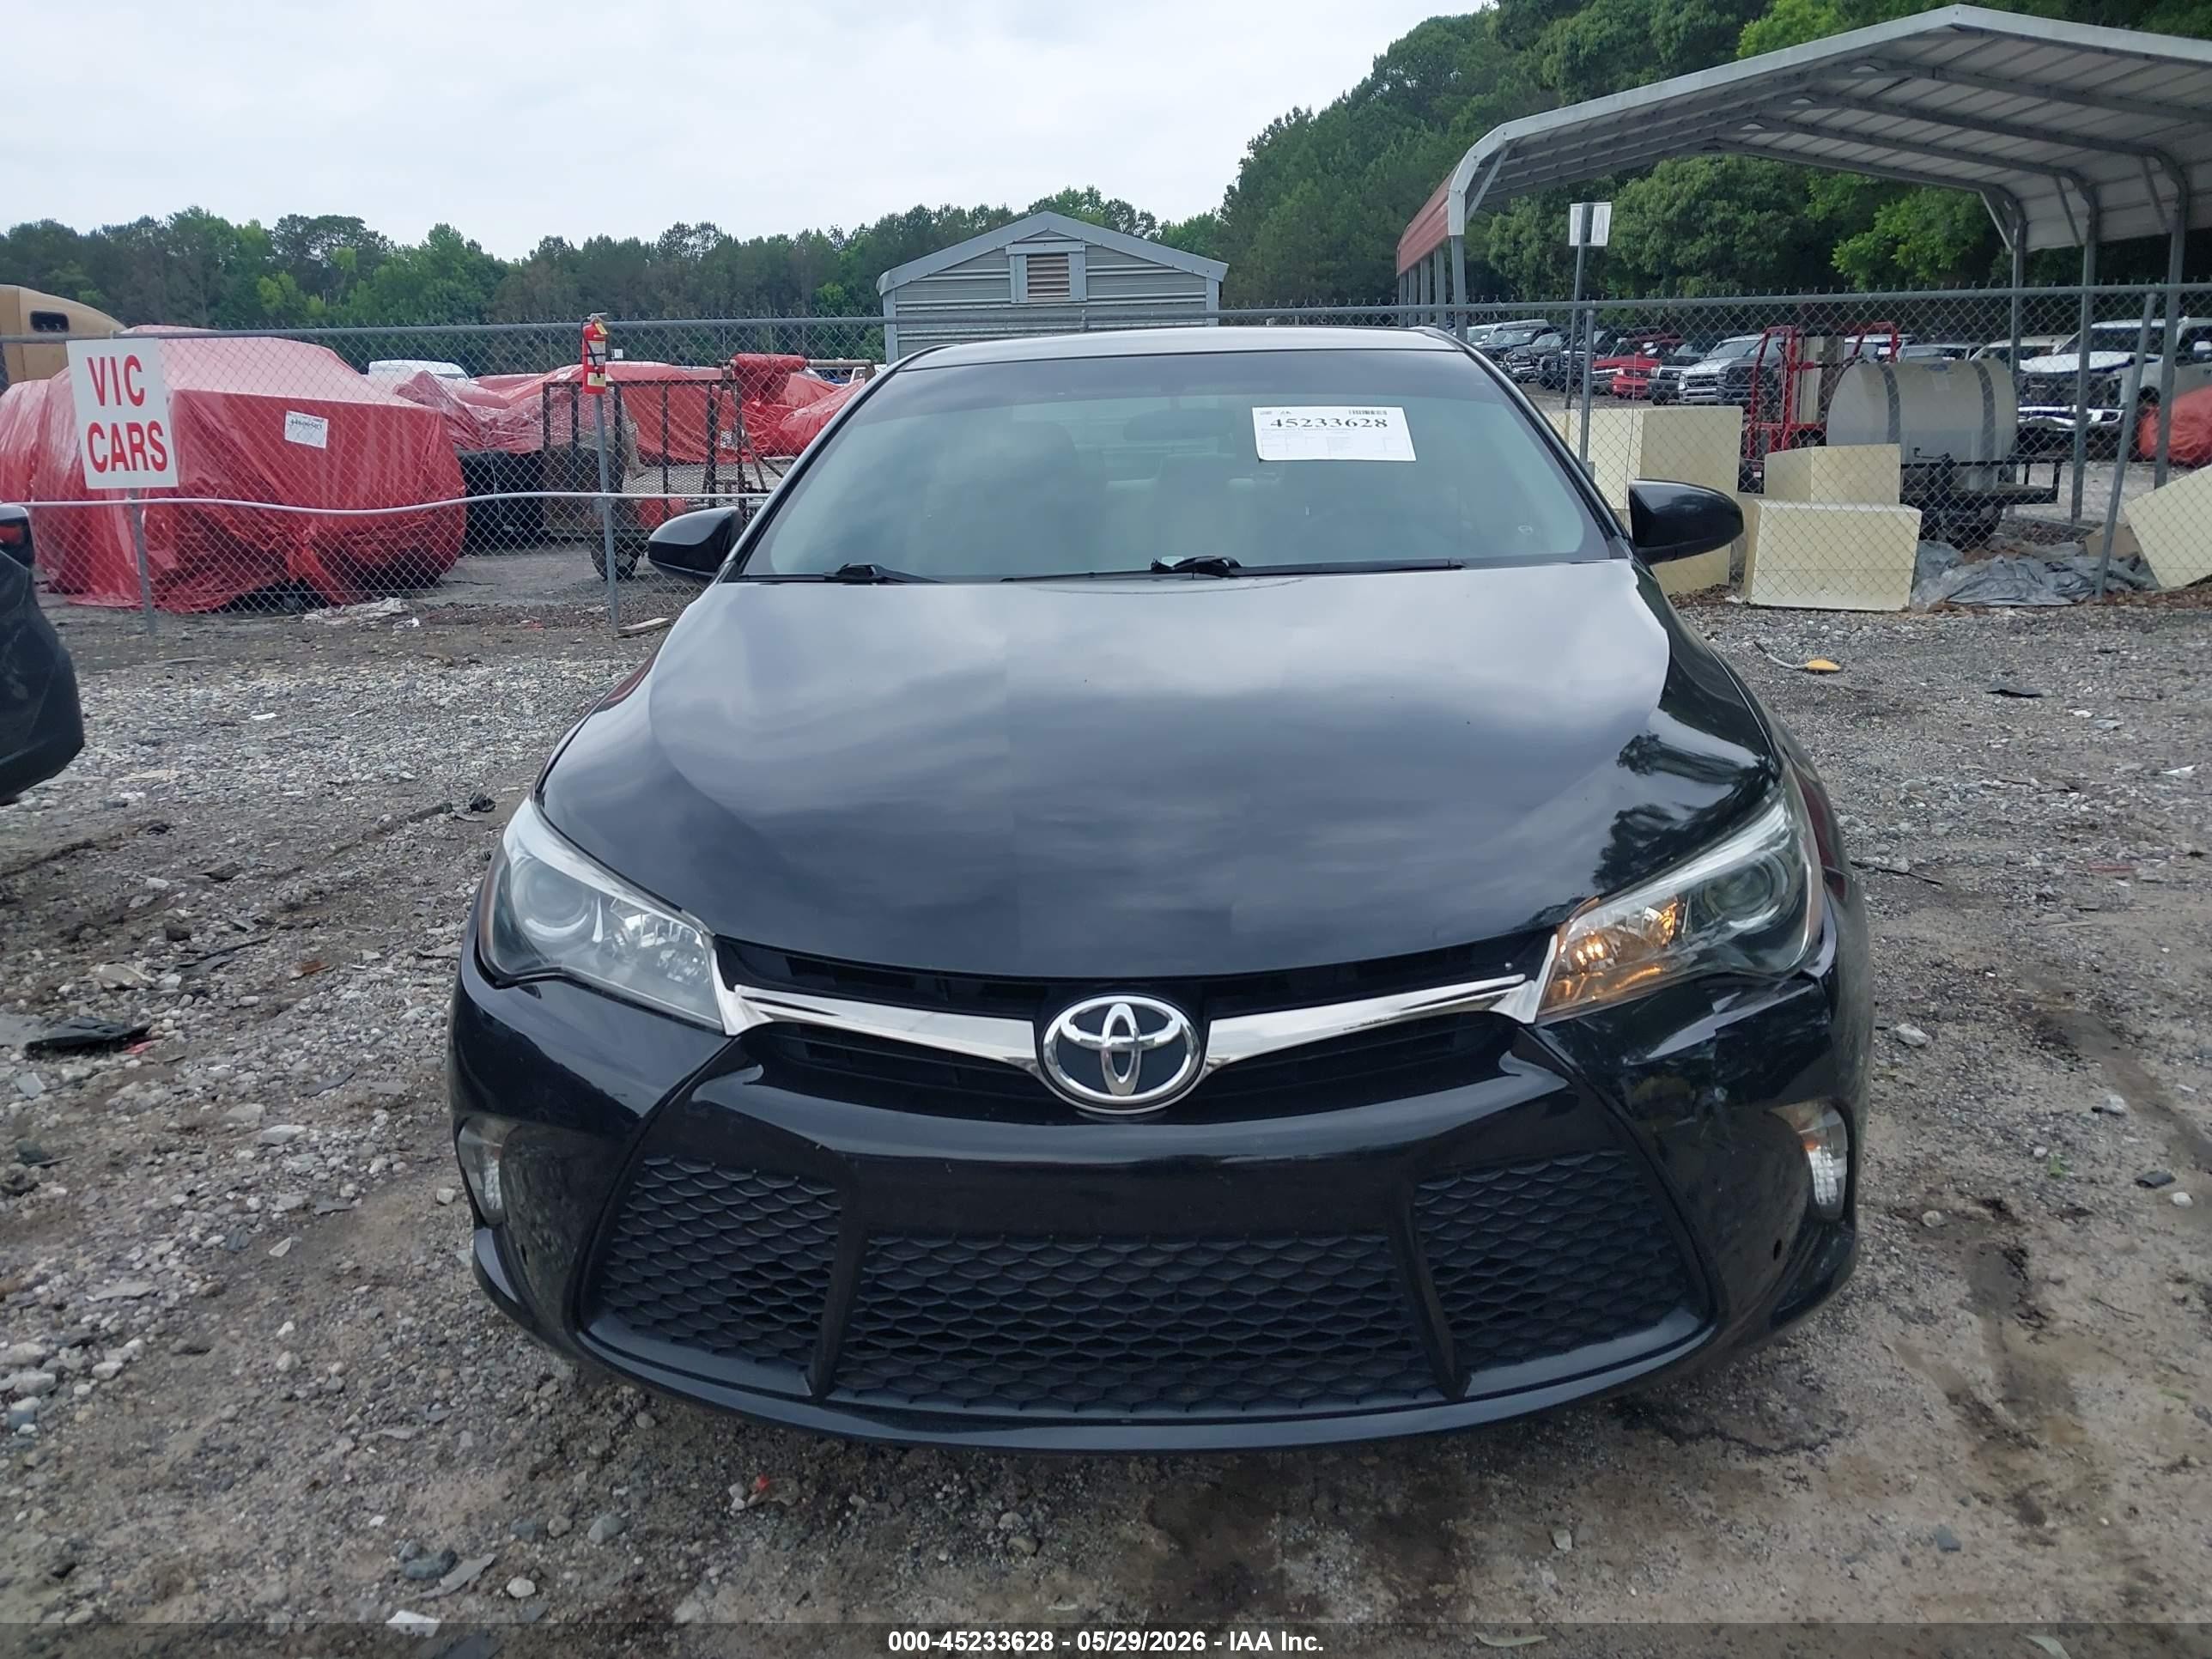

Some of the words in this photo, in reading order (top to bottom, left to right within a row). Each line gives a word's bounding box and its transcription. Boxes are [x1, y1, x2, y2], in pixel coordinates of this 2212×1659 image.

[87, 355, 145, 406] VIC
[88, 420, 168, 473] CARS
[1270, 418, 1388, 428] 45233628
